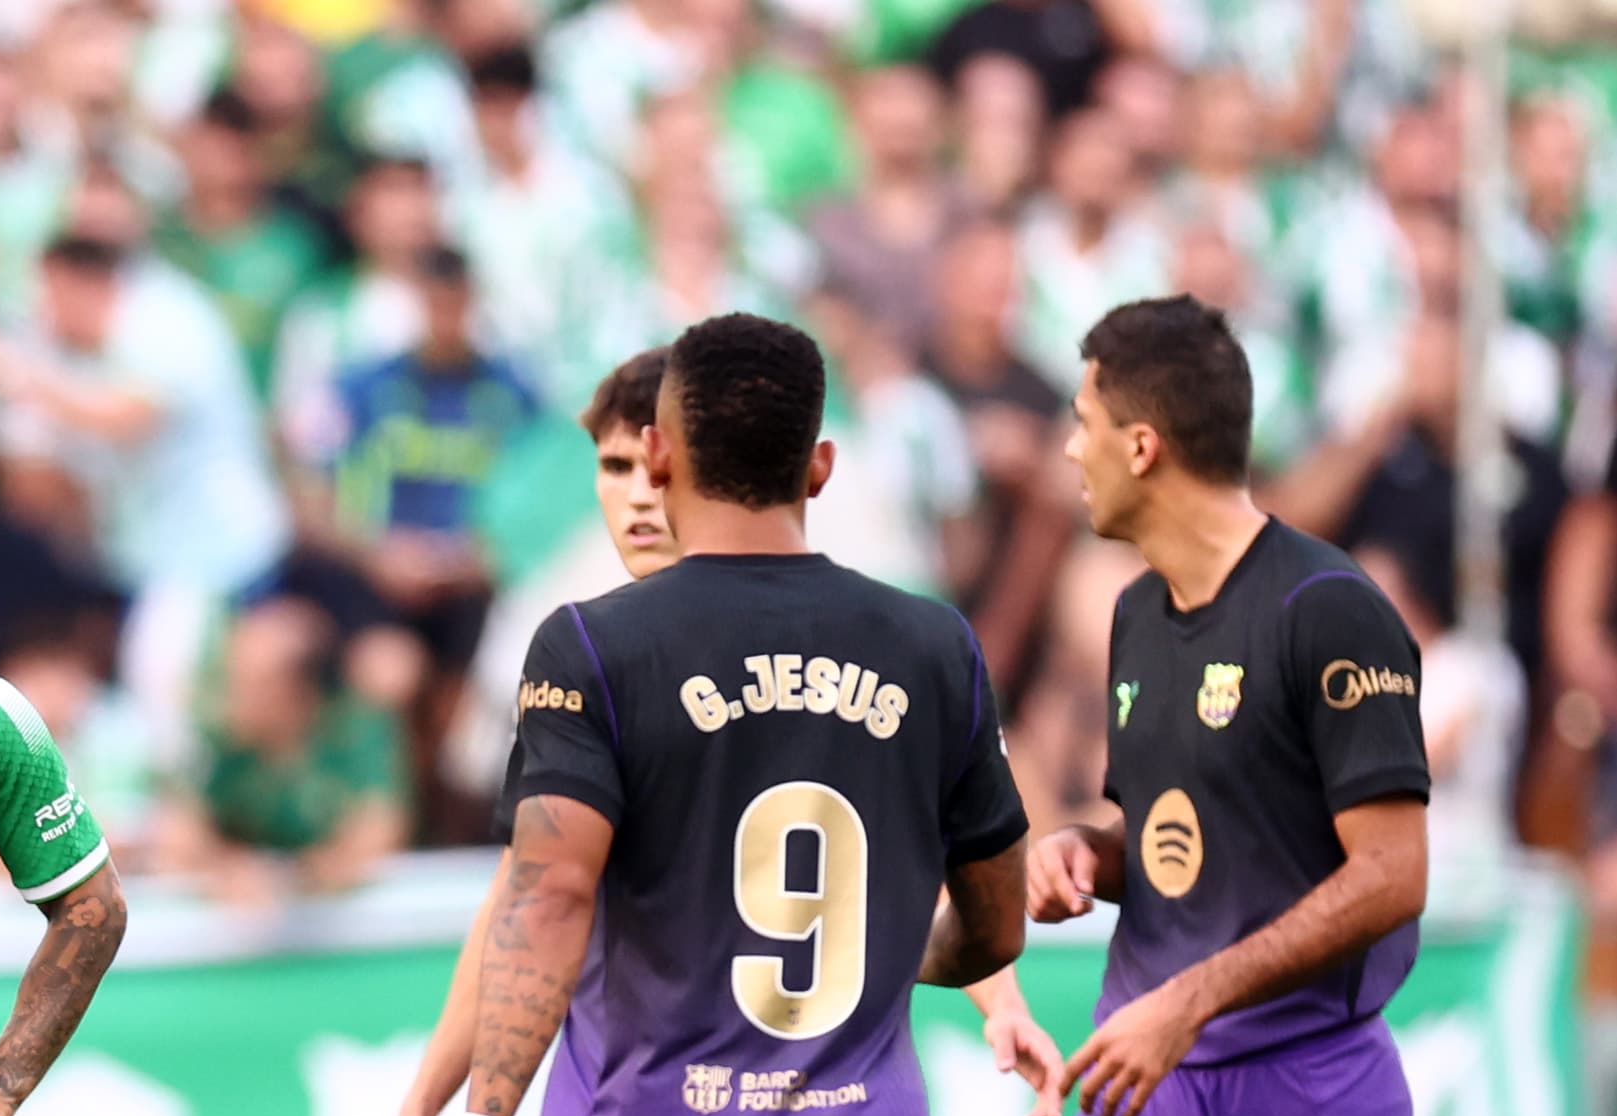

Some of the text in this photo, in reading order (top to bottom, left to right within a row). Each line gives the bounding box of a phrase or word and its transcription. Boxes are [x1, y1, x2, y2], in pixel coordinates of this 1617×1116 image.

[680, 654, 909, 740] G.JESUS
[1321, 659, 1415, 710] Midea
[731, 780, 869, 1041] 9
